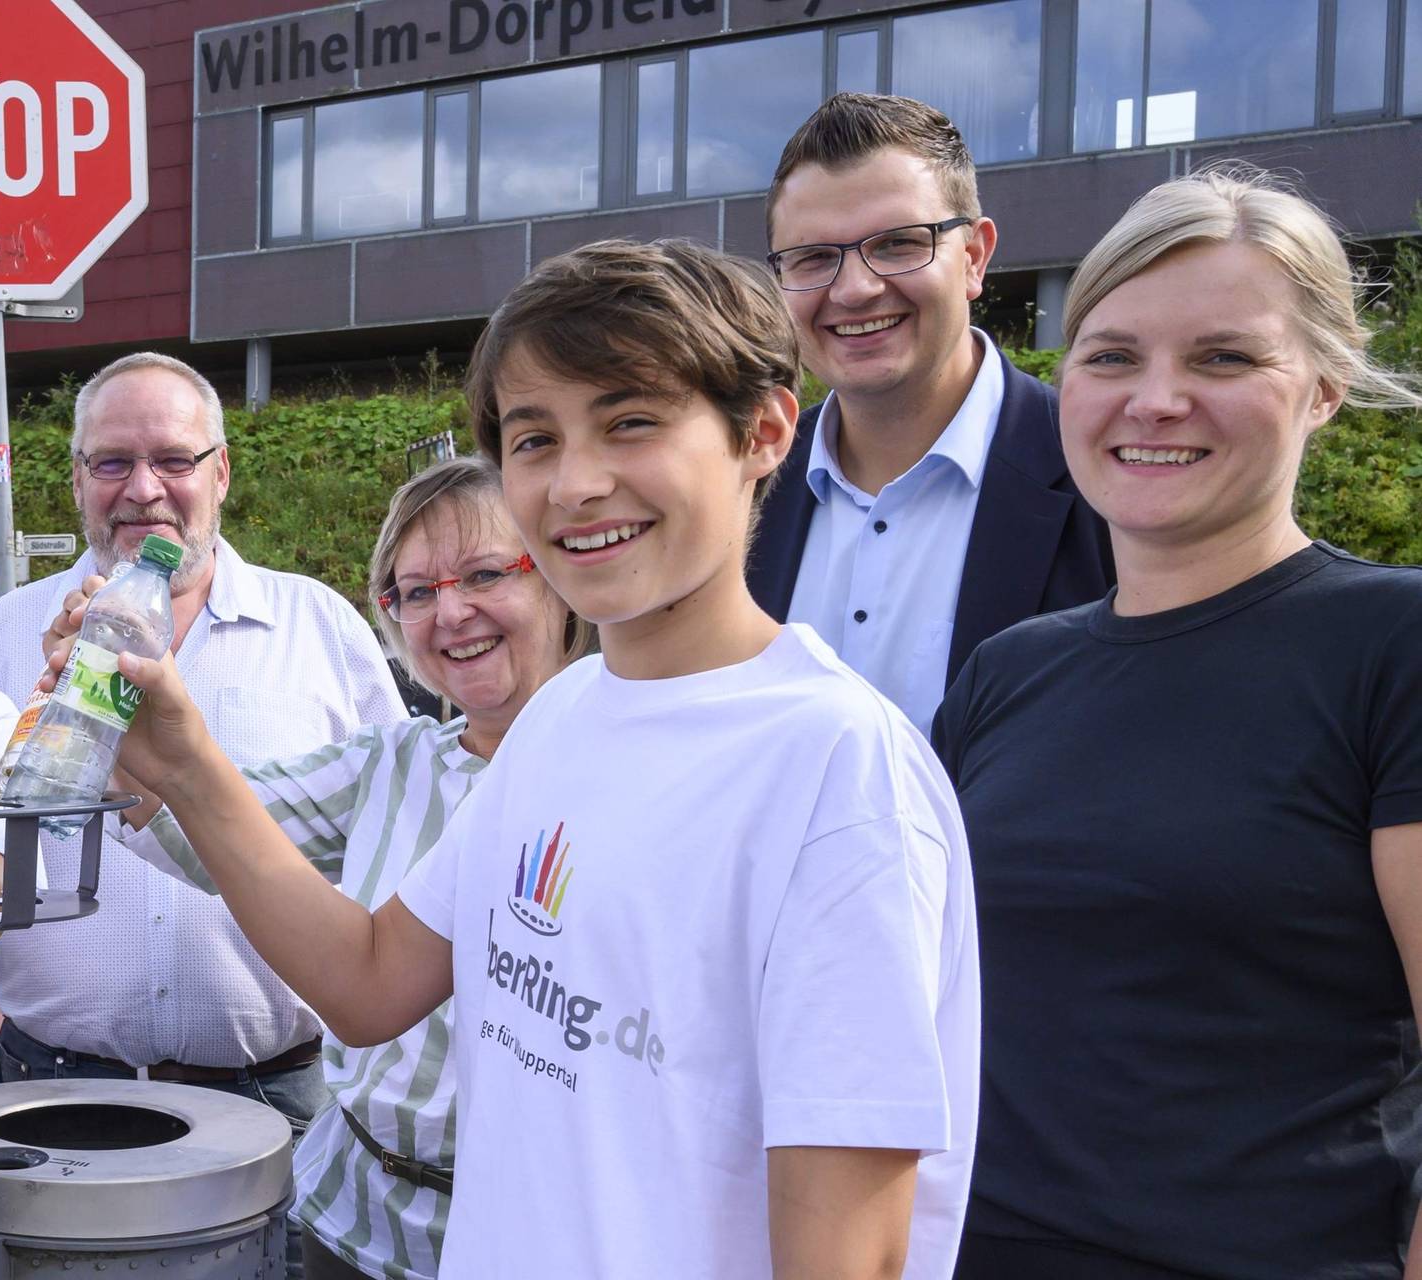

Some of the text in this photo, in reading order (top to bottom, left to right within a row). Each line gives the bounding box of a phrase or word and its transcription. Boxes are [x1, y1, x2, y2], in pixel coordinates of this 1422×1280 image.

[487, 908, 666, 1077] perRing.de
[497, 1024, 515, 1051] für
[513, 1036, 578, 1093] Wuppertal
